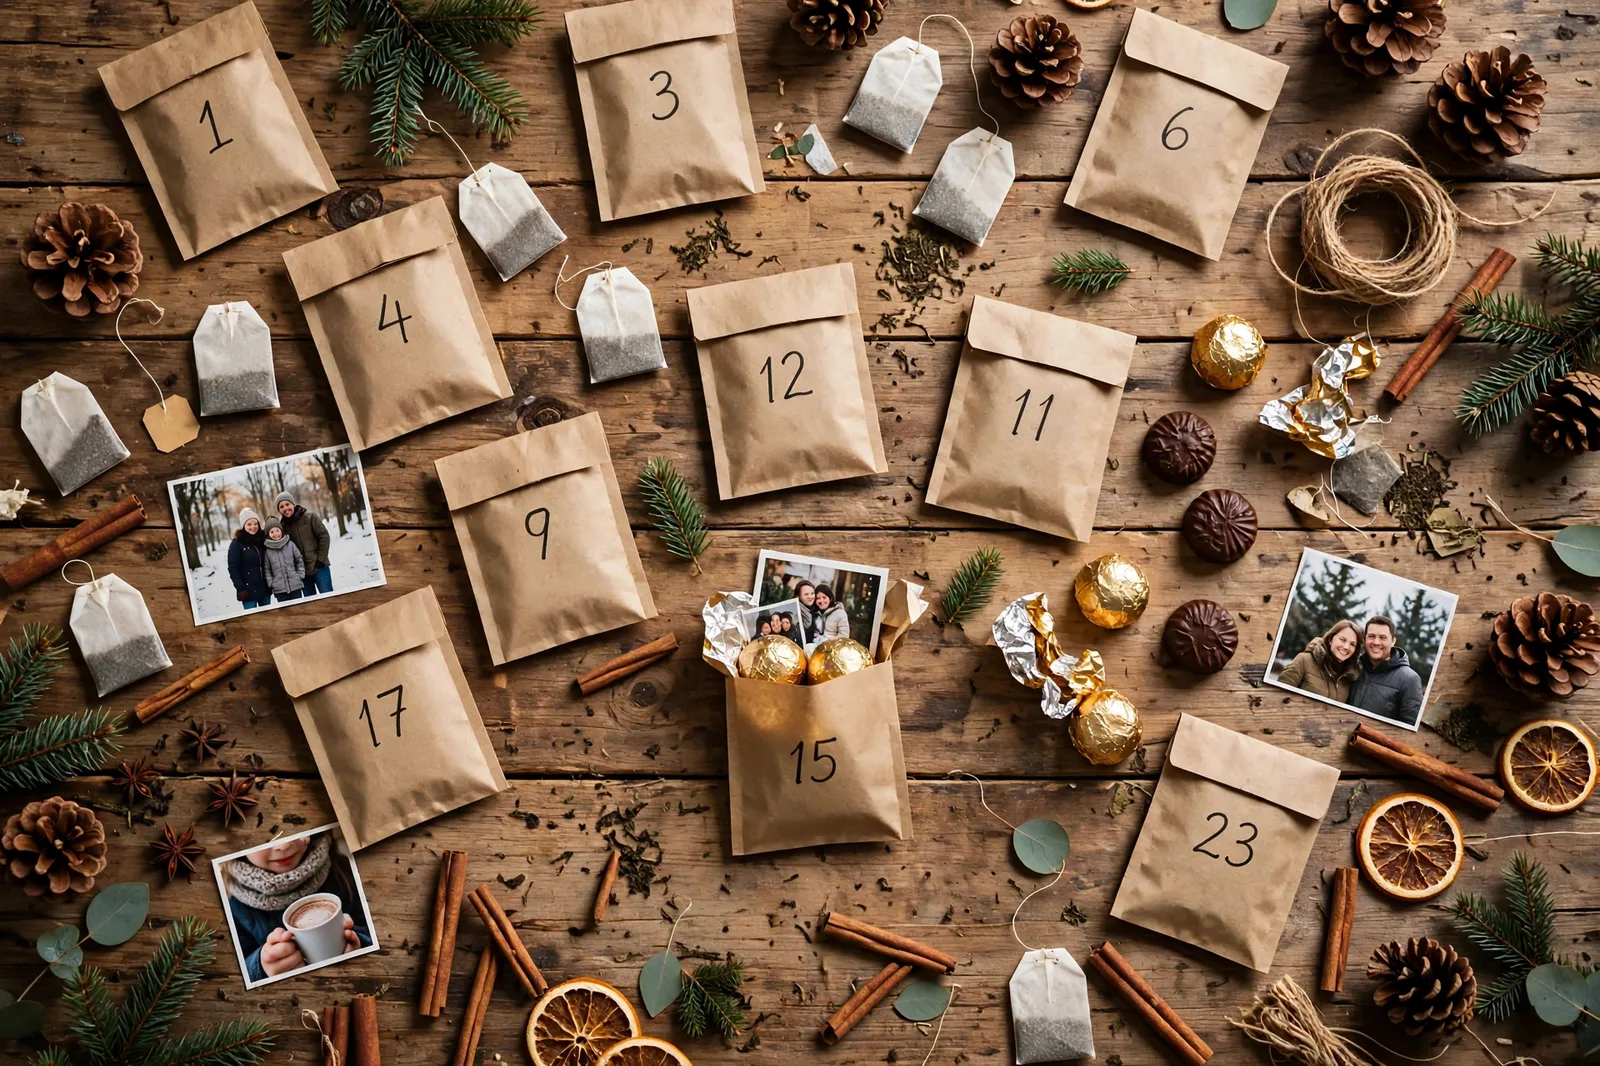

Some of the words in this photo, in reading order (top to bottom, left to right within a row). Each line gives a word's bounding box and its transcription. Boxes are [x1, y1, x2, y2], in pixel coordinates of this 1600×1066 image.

[649, 70, 680, 121] 3
[199, 99, 234, 155] 1
[1161, 106, 1194, 151] 6
[377, 293, 413, 344] 4
[759, 350, 814, 404] 12
[1011, 388, 1055, 442] 11
[524, 507, 551, 561] 9
[358, 683, 407, 748] 17
[790, 736, 838, 785] 15
[1192, 811, 1259, 868] 23
